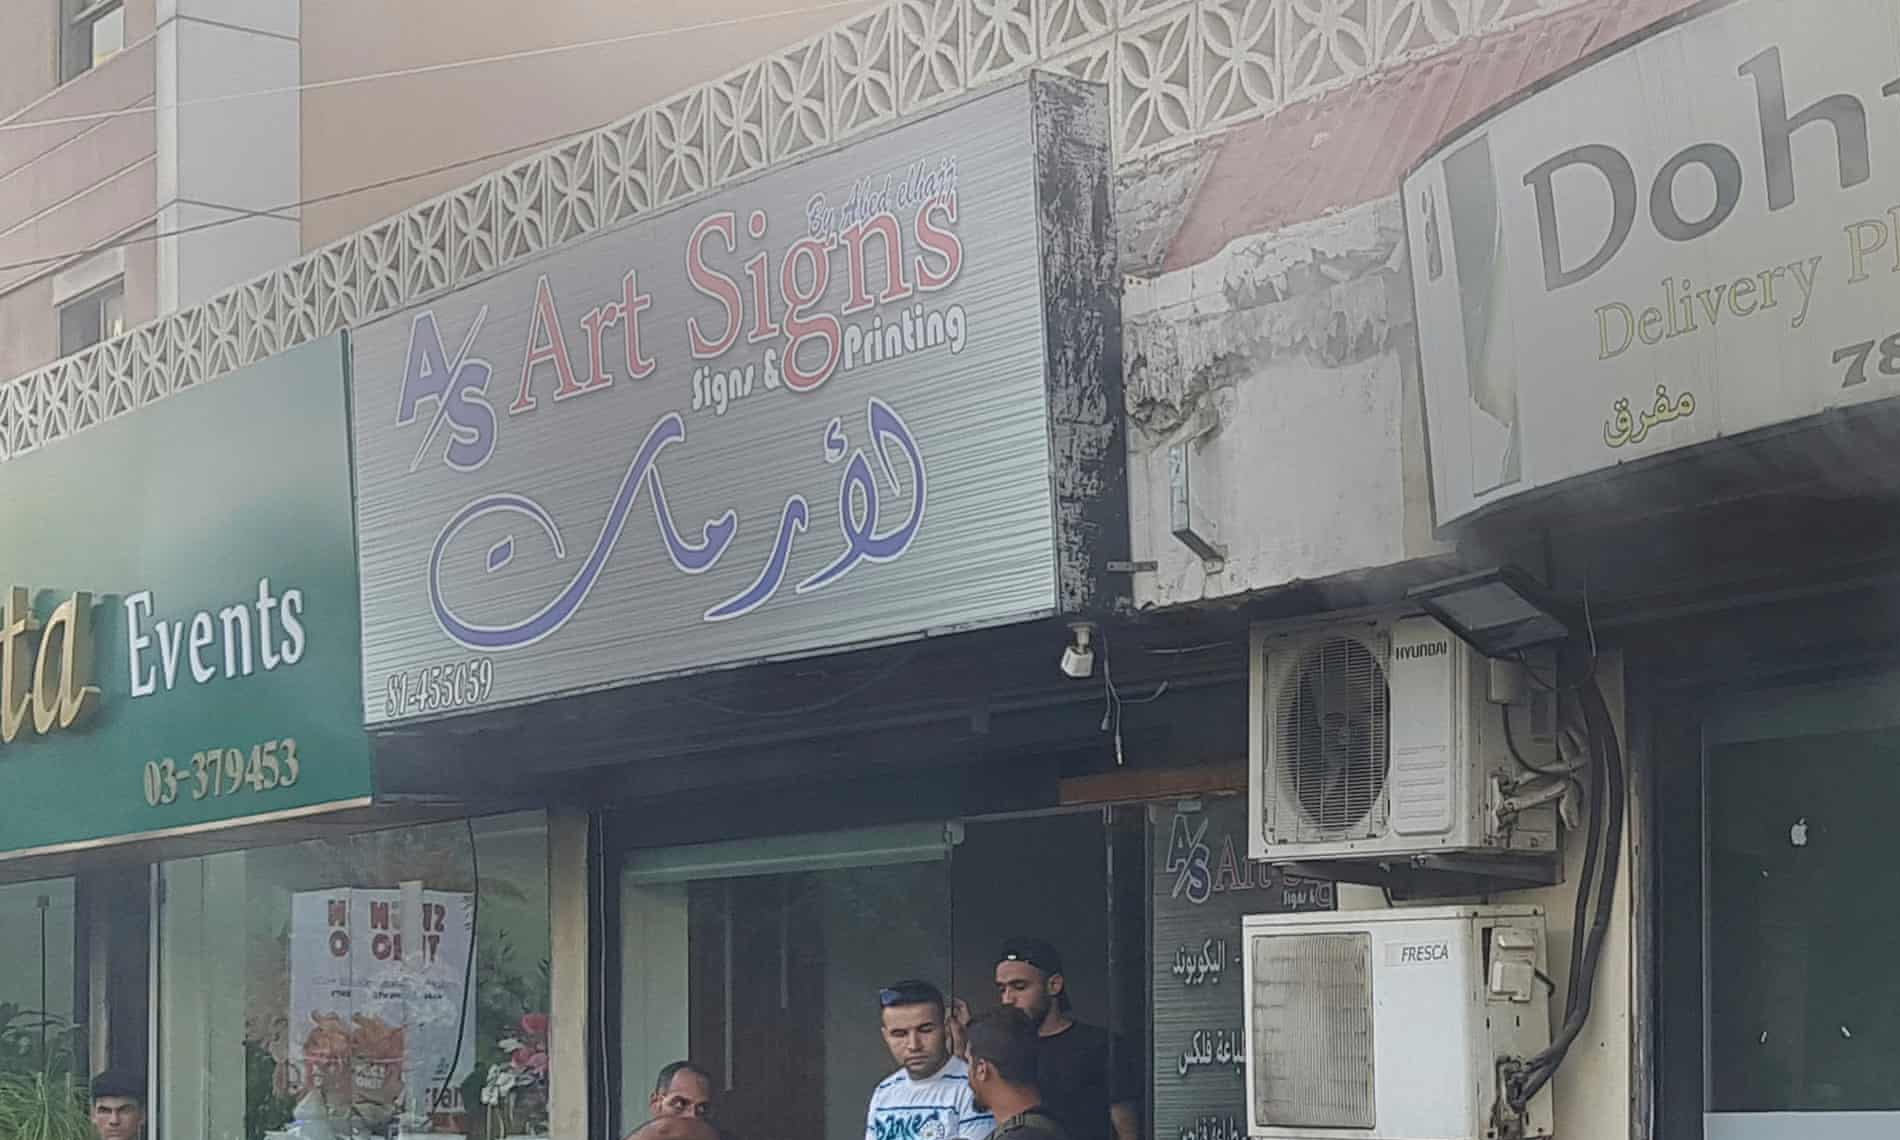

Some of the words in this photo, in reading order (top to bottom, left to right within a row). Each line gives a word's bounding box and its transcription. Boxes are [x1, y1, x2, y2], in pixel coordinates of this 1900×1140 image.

[508, 268, 656, 415] Art
[686, 192, 964, 393] Signs
[1594, 255, 1823, 361] Delivery
[692, 364, 755, 416] Signs
[843, 303, 968, 371] Printing
[1603, 384, 1697, 449] مفرق
[0, 582, 101, 744] ta
[124, 577, 305, 698] Events
[1395, 640, 1448, 661] HYUNDAI
[143, 737, 299, 807] 03-379453
[1400, 943, 1450, 963] FRESCA
